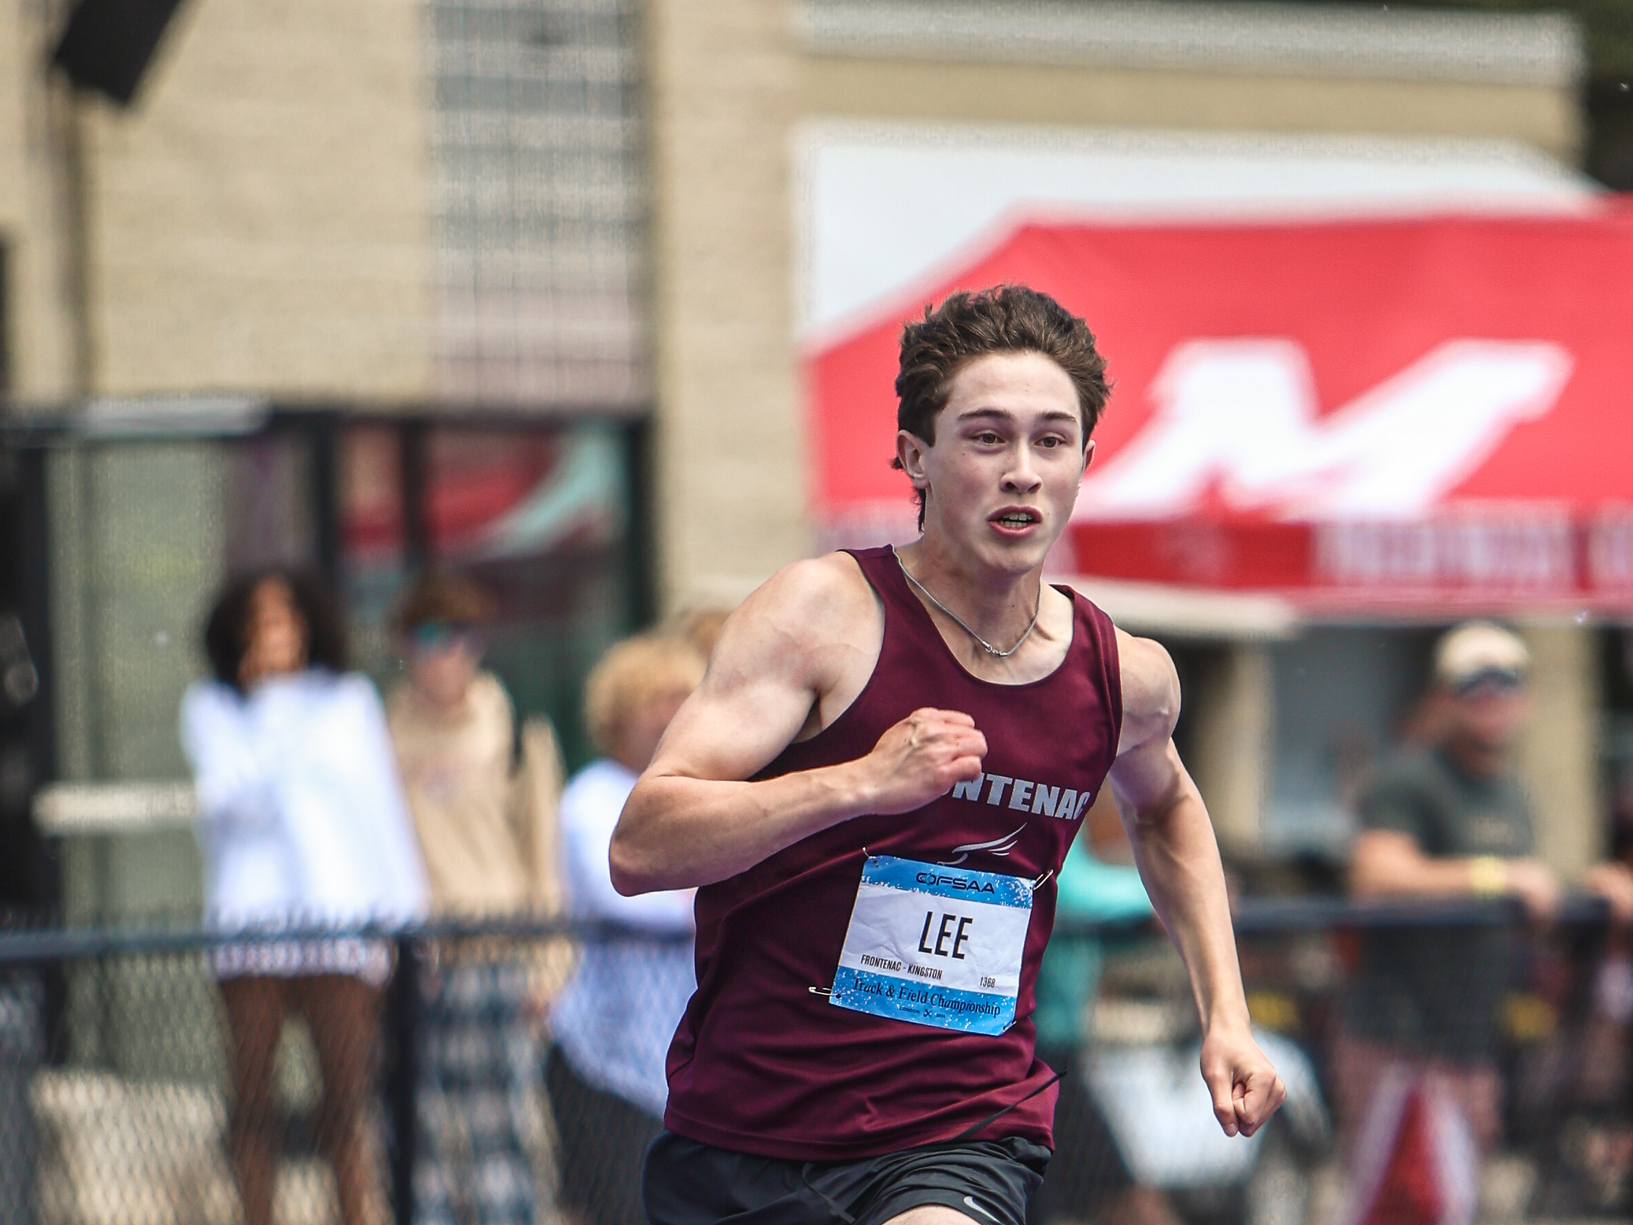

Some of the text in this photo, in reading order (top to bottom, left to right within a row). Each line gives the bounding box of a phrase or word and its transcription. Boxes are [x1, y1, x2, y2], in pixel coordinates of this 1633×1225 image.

[952, 772, 1090, 820] NTENAC
[918, 911, 973, 960] LEE
[861, 954, 902, 972] FRONTENAC
[907, 964, 943, 980] KINGSTON
[979, 976, 996, 988] 1368
[853, 977, 1001, 1018] Track & Field Championship
